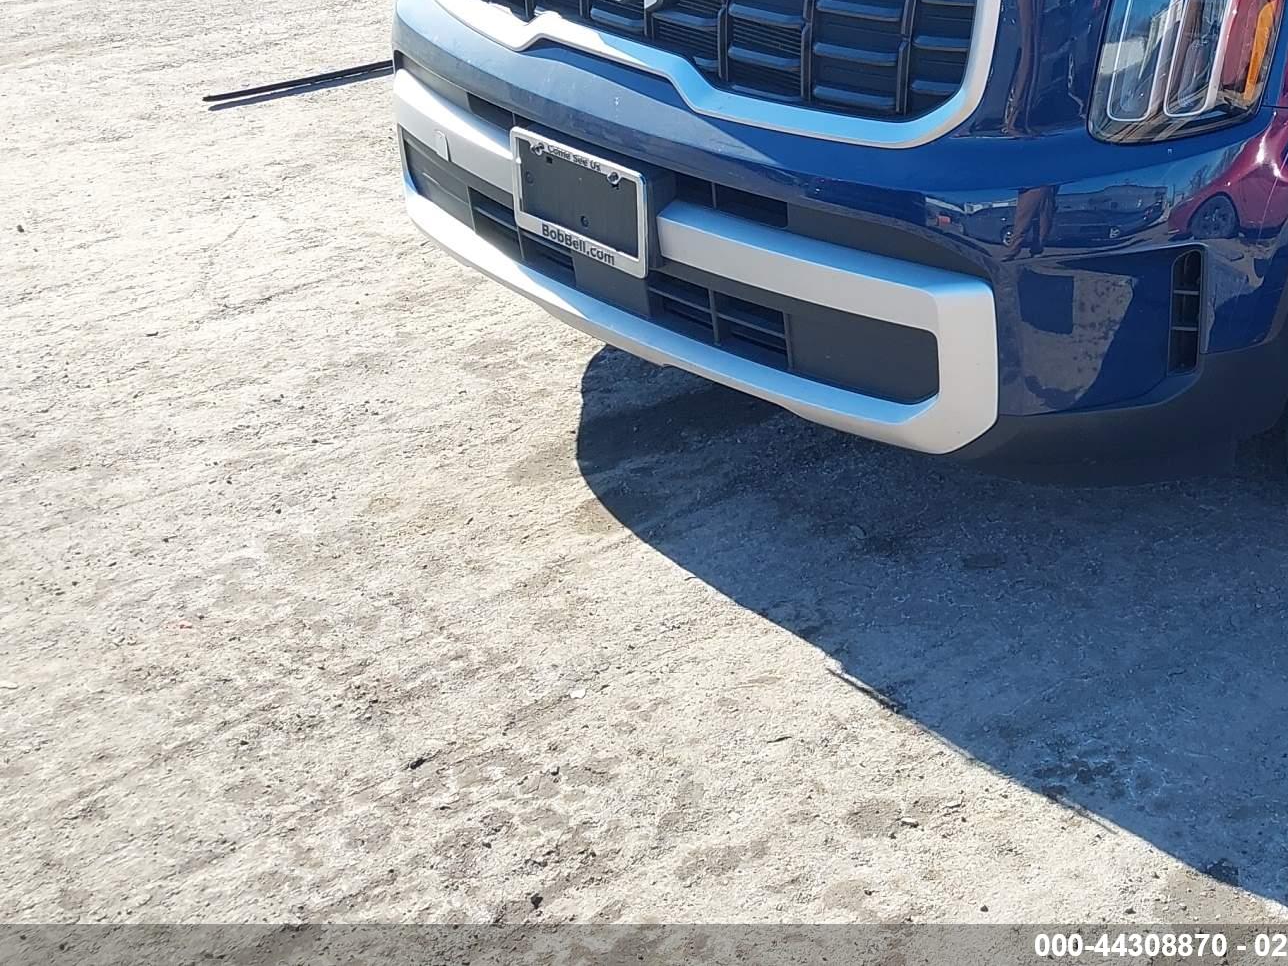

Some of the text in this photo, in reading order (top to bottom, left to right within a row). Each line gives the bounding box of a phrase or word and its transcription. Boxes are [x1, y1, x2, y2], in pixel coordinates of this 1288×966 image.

[548, 145, 601, 170] Come See Us
[541, 223, 615, 266] BobBell.com
